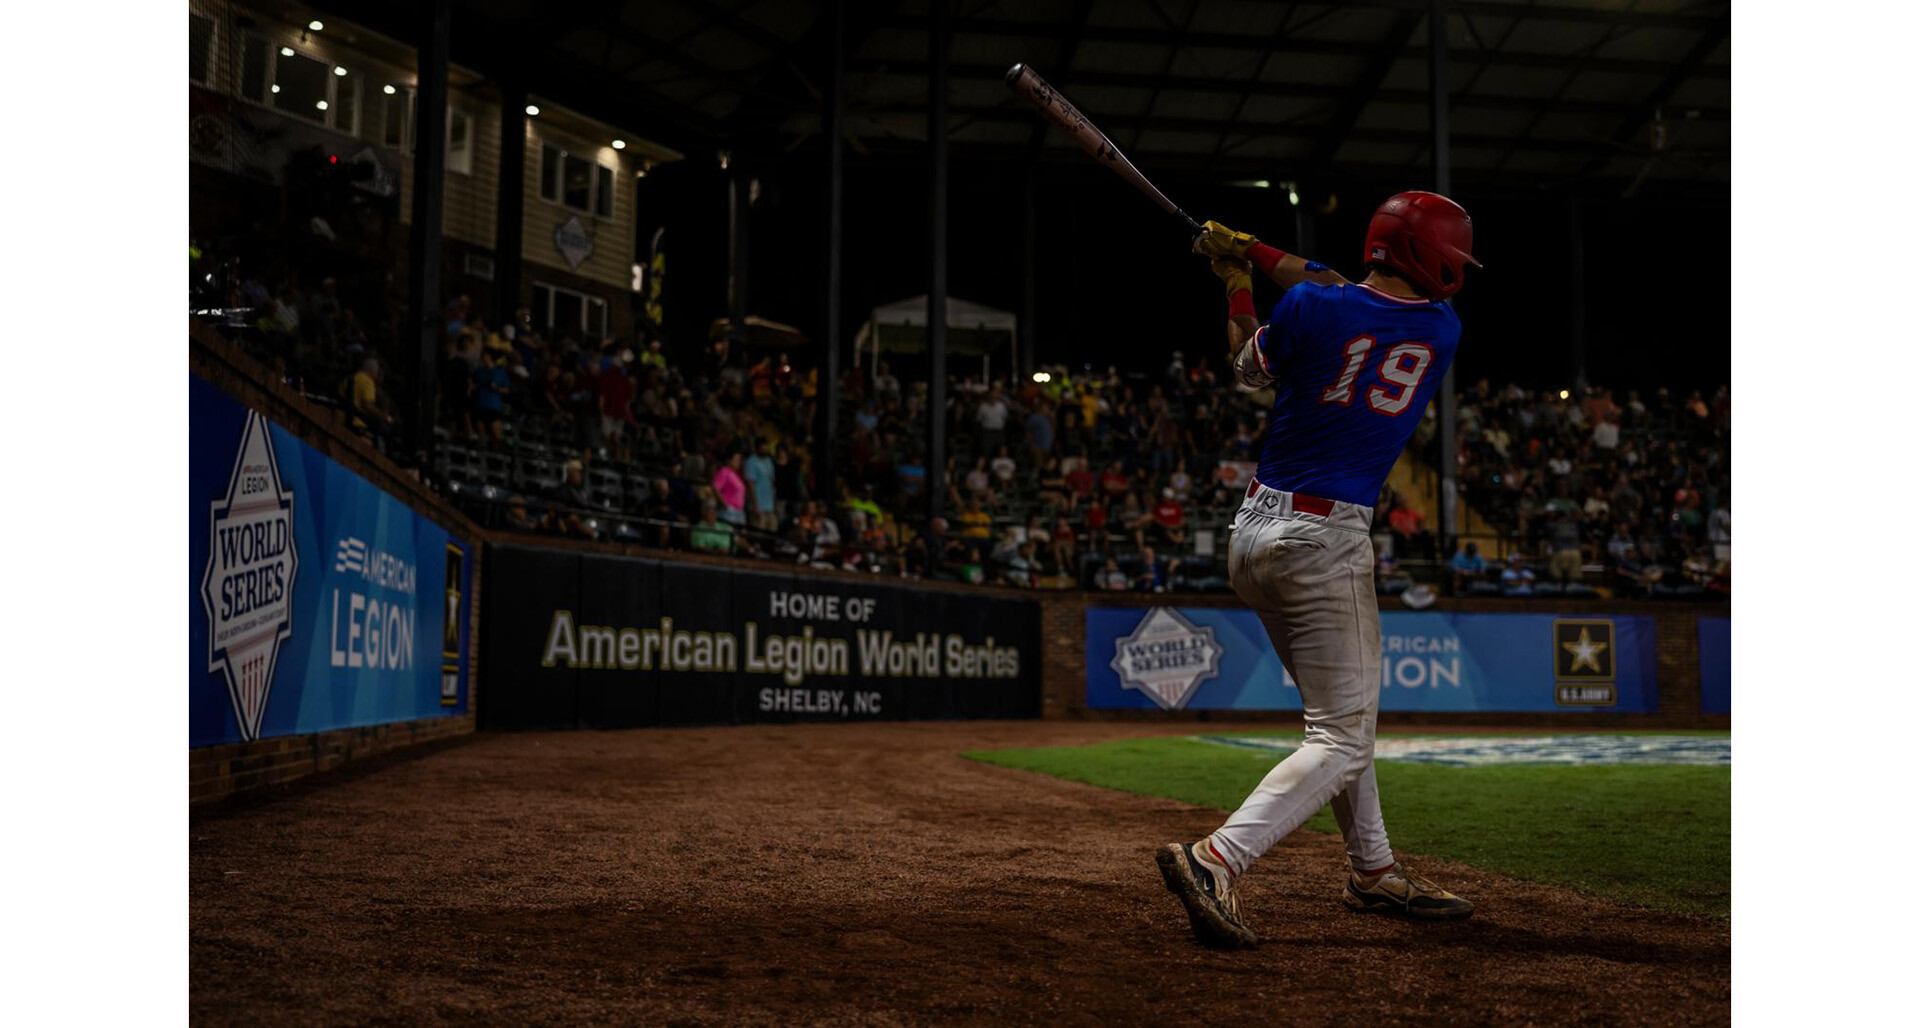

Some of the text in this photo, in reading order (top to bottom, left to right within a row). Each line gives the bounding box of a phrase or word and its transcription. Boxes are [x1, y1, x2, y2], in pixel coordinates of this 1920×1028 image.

[1318, 333, 1436, 418] 19
[242, 476, 270, 495] LEGION
[220, 518, 287, 570] WORLD
[221, 561, 284, 622] SERIES
[361, 546, 417, 595] AMERICAN
[331, 587, 415, 671] LEGION
[769, 590, 877, 623] HOME OF
[540, 608, 1020, 687] American Legion World Series
[1128, 637, 1206, 658] WORLD
[1131, 651, 1205, 672] SERIES
[758, 687, 883, 717] SHELBY, NC
